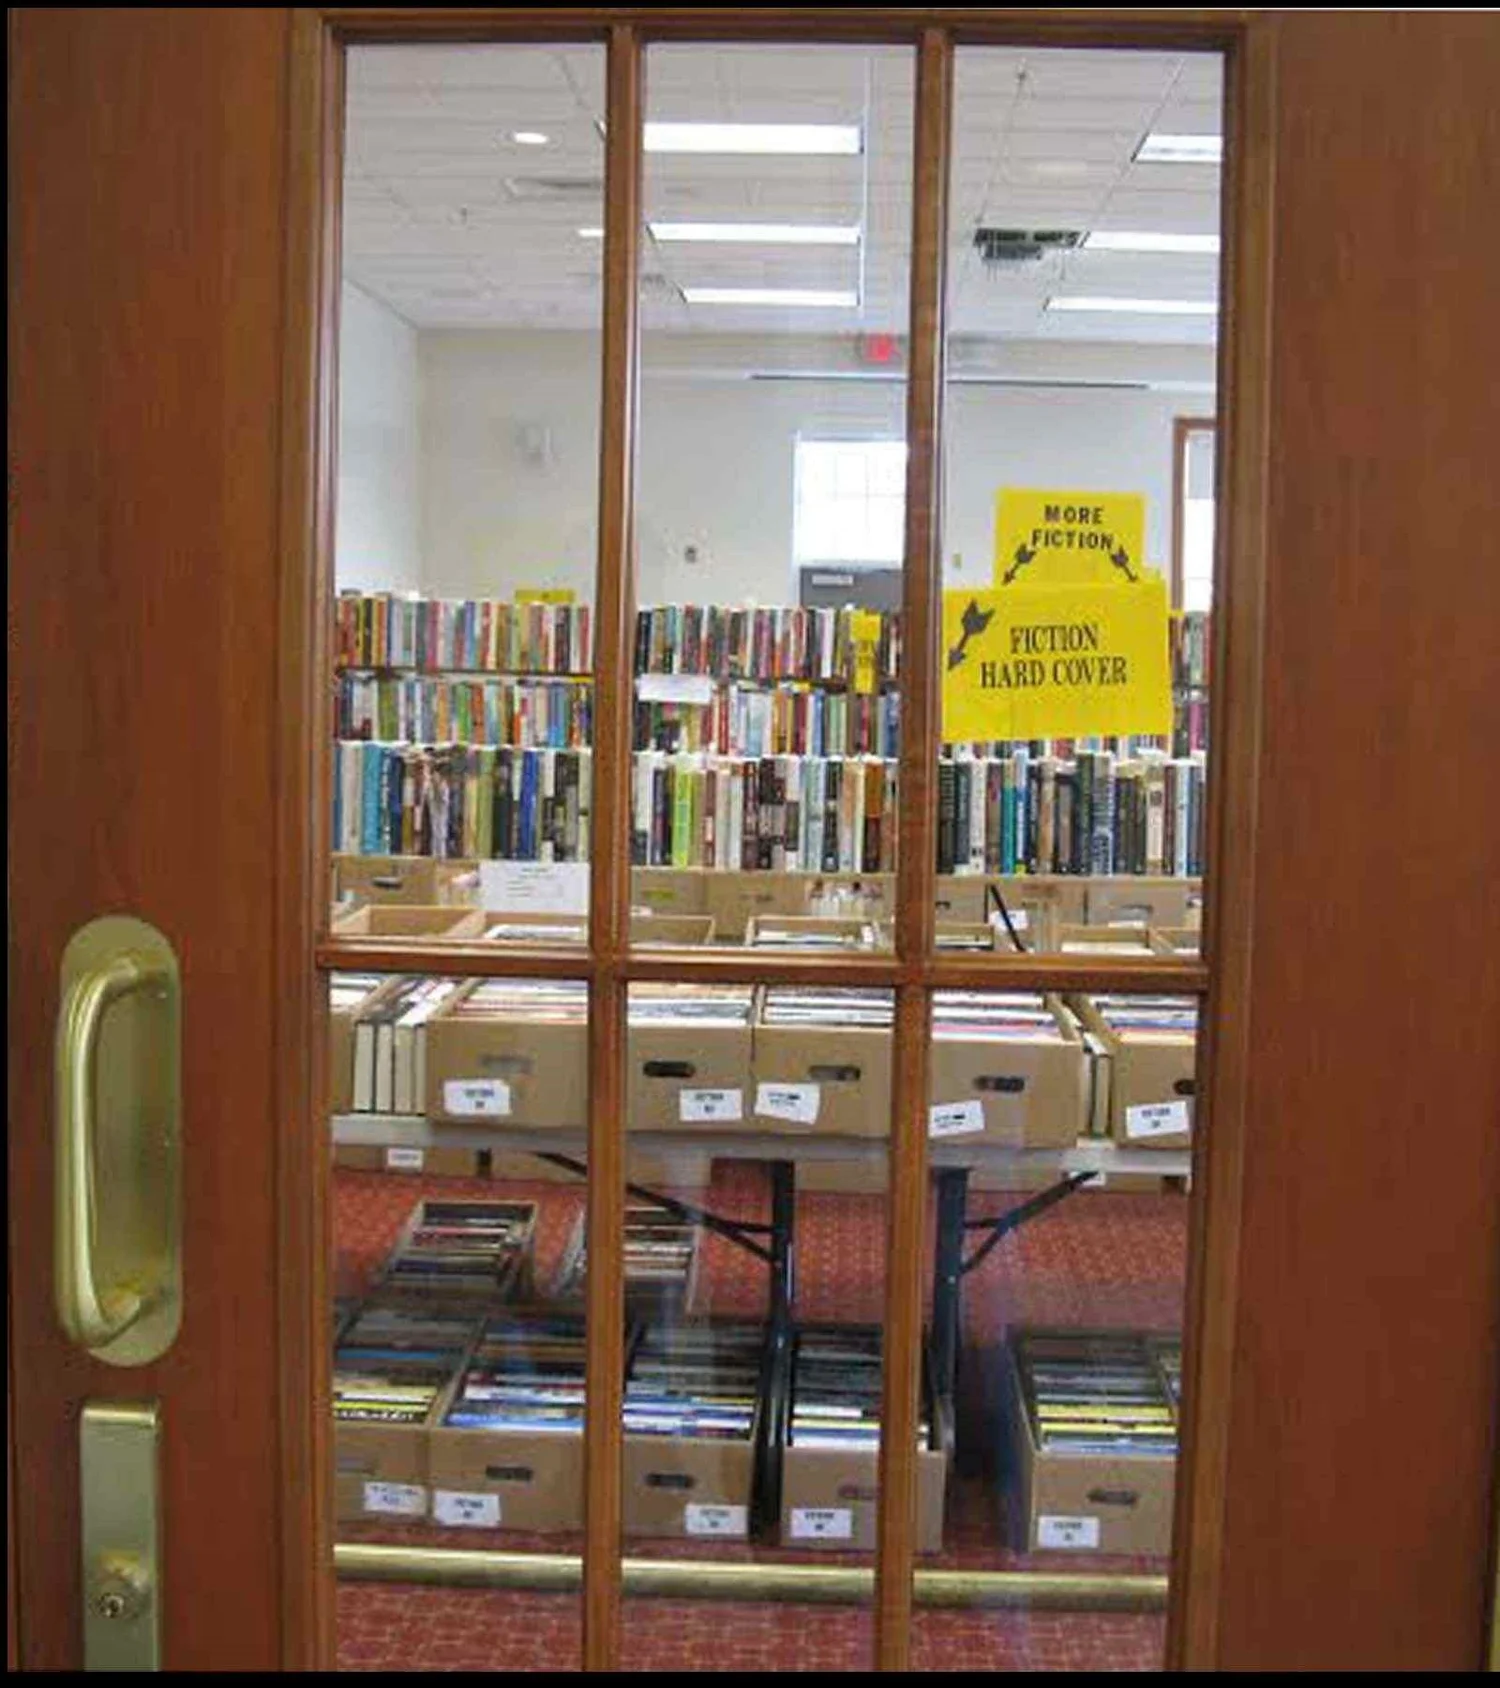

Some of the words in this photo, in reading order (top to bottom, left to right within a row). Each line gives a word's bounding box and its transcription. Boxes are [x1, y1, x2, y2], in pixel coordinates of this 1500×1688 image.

[1044, 504, 1104, 524] MORE
[1031, 528, 1115, 550] FICTION
[1010, 624, 1099, 654] FICTION
[980, 659, 1046, 689] HARD
[1053, 656, 1128, 686] COVER
